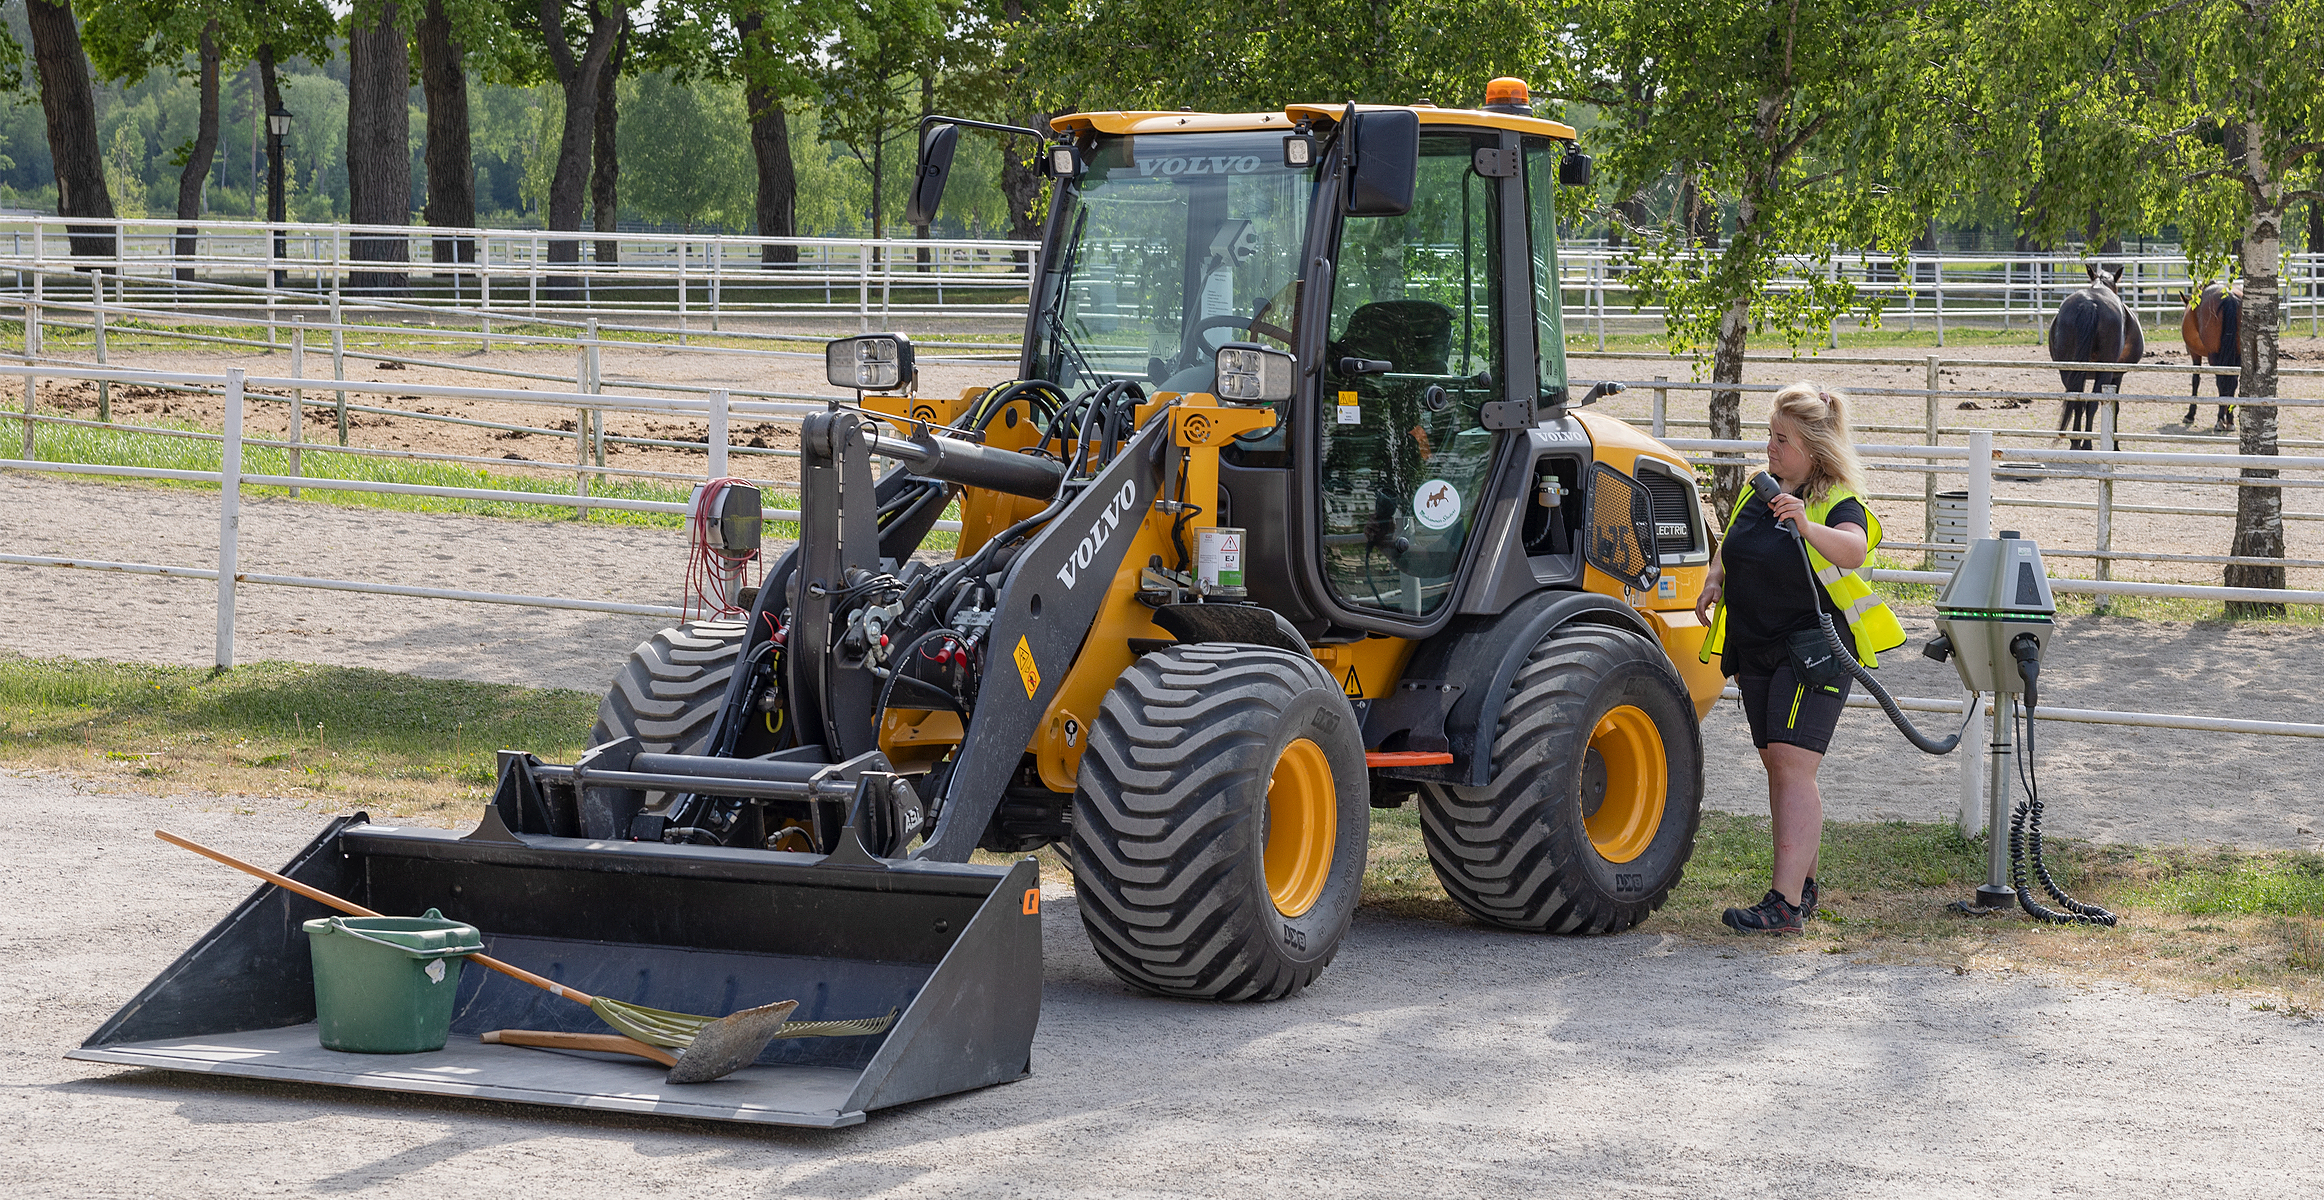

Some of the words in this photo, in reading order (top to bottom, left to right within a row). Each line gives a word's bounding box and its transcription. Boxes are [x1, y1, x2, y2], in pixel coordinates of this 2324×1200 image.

[1136, 155, 1261, 176] VOLVO
[1534, 431, 1583, 442] VOLVO
[1056, 479, 1136, 590] VOLVO
[1656, 525, 1687, 536] ECTRIC
[904, 805, 923, 834] ABL
[1616, 873, 1643, 891] BKT
[1283, 923, 1307, 952] BKT
